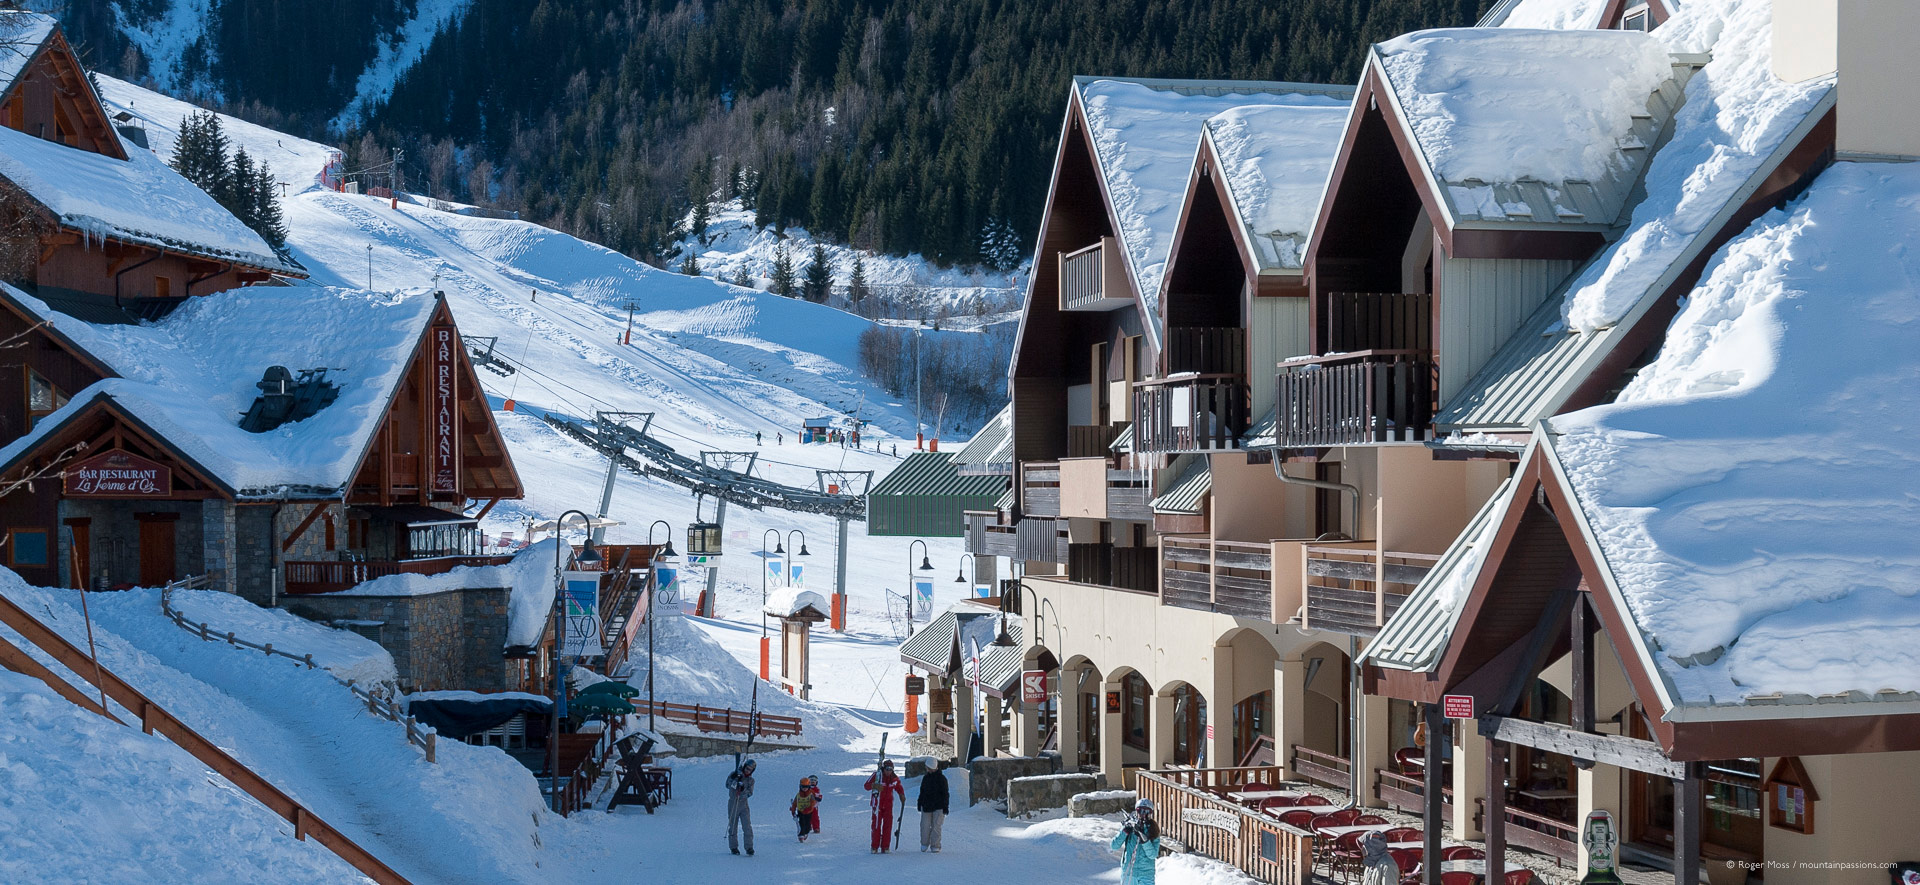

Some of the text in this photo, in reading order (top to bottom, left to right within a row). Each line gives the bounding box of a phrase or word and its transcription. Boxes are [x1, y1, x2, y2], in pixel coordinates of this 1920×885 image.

[439, 331, 449, 361] BAR
[439, 365, 450, 467] RESTAURANT
[80, 469, 157, 479] BAR RESTAURANT
[74, 478, 91, 492] La
[658, 590, 678, 605] OZ
